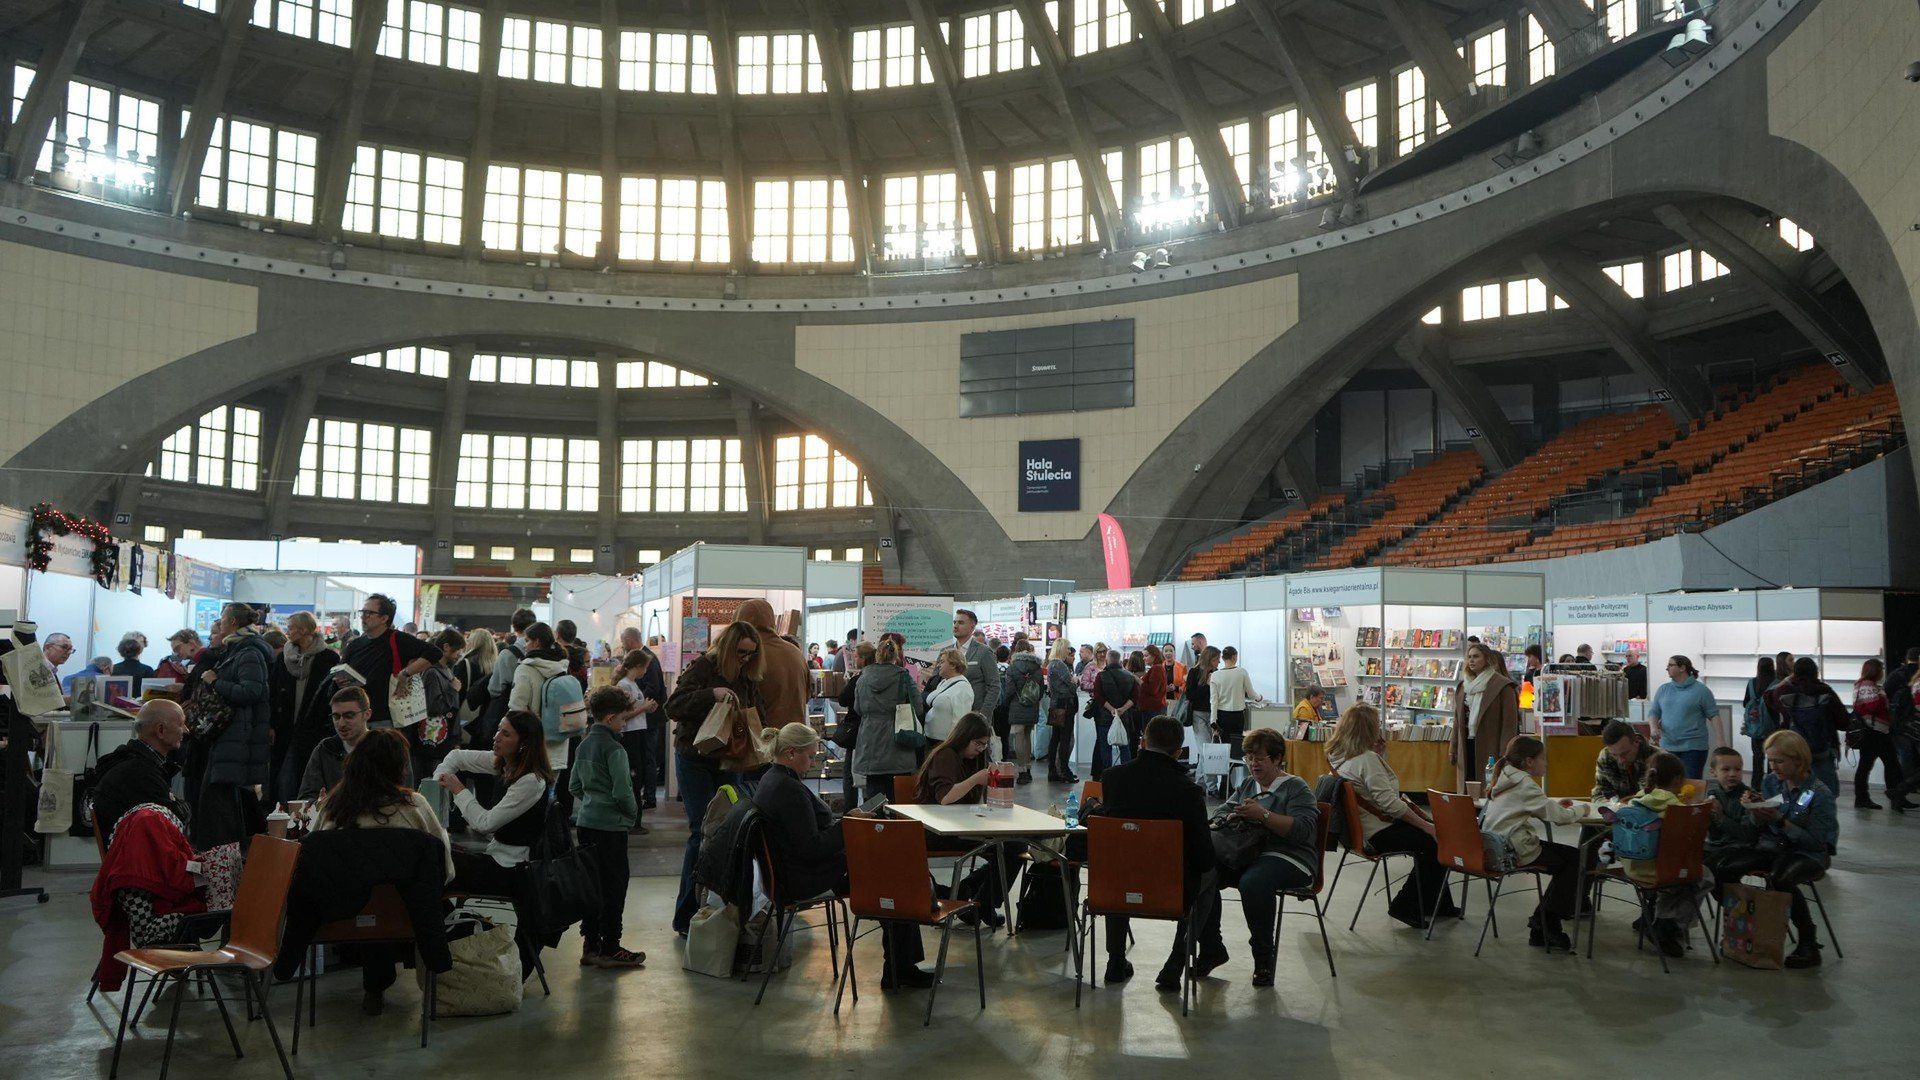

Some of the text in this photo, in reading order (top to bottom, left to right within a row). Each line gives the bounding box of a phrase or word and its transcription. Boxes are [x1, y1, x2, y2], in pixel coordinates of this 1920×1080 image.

[1026, 458, 1053, 470] Hala
[1026, 468, 1072, 481] Stulecia
[116, 515, 129, 523] D1
[1288, 587, 1303, 597] Agade
[1303, 586, 1311, 595] Bis
[1600, 601, 1629, 611] Politycznej
[1667, 603, 1733, 613] Wydawnictwo Abyssos
[1598, 611, 1629, 619] Narutowicza
